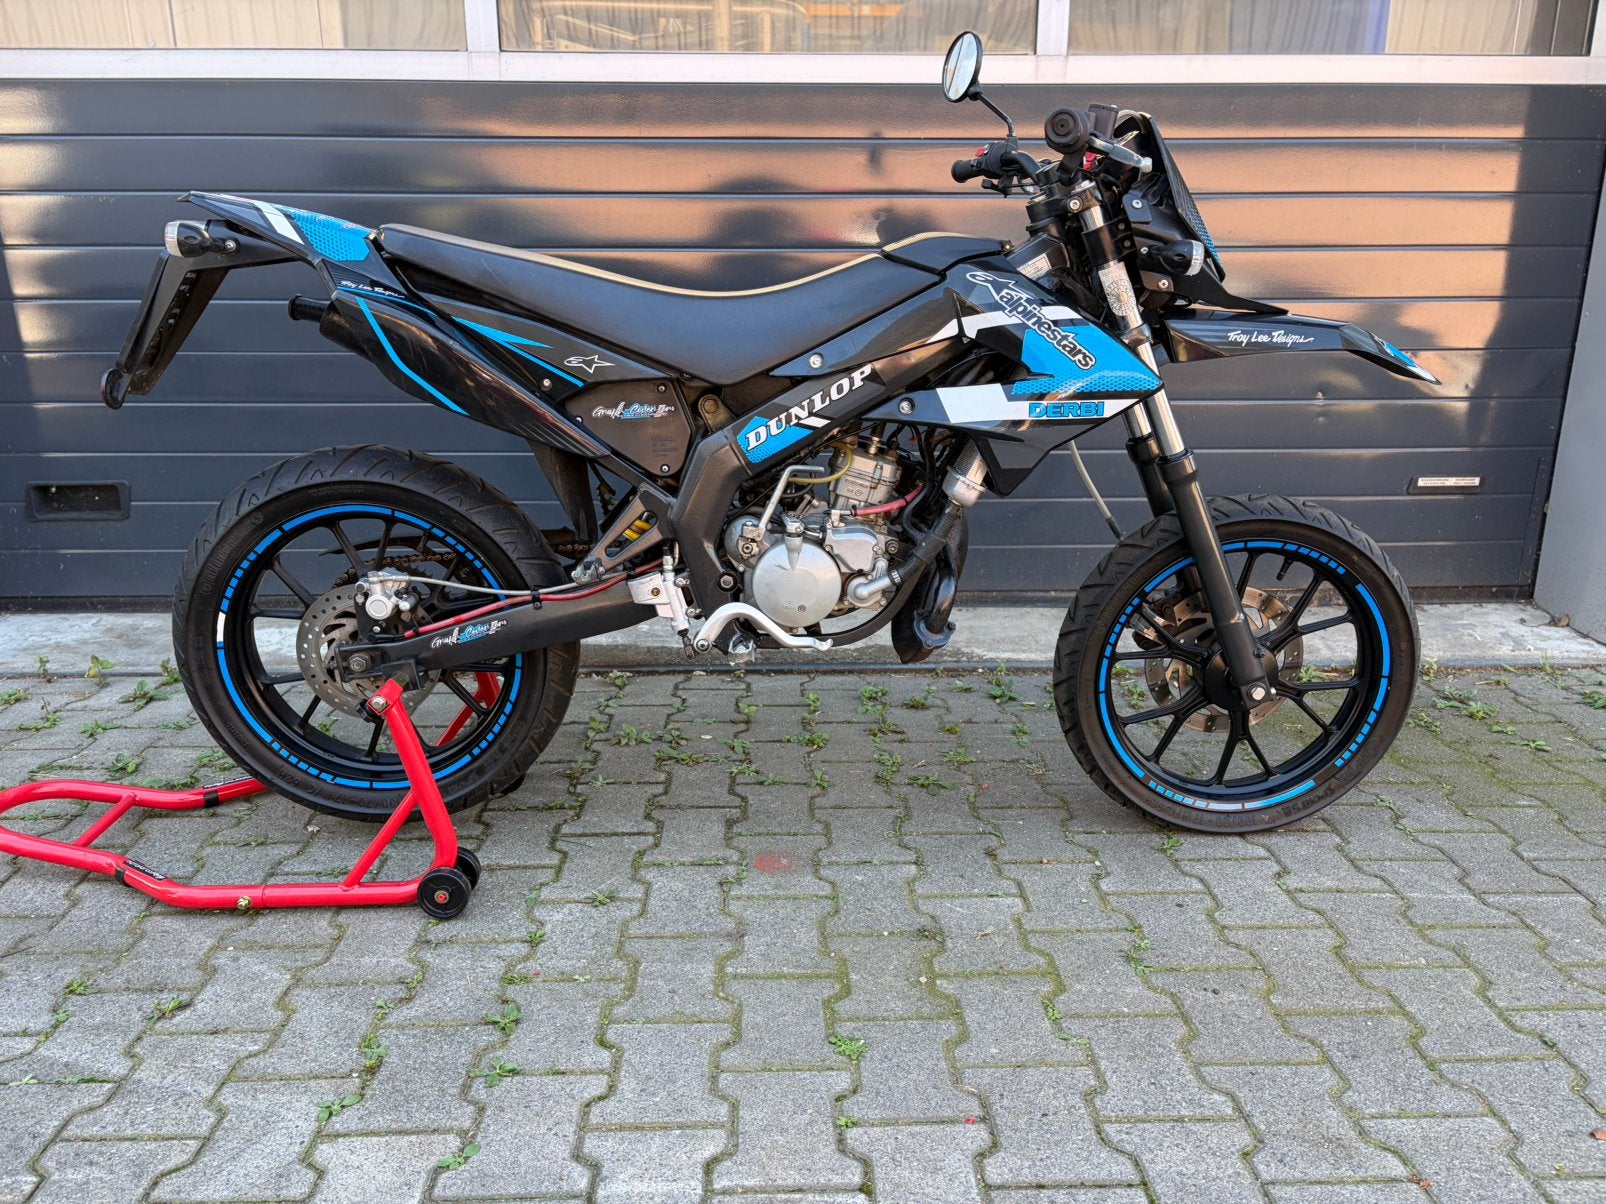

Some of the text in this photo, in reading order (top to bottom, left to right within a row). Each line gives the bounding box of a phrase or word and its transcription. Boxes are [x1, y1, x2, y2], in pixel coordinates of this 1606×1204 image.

[999, 290, 1096, 369] alpinestars
[1227, 330, 1314, 347] Troy Lee Designs
[746, 363, 873, 451] DUNLOP
[1028, 401, 1105, 418] DERBI
